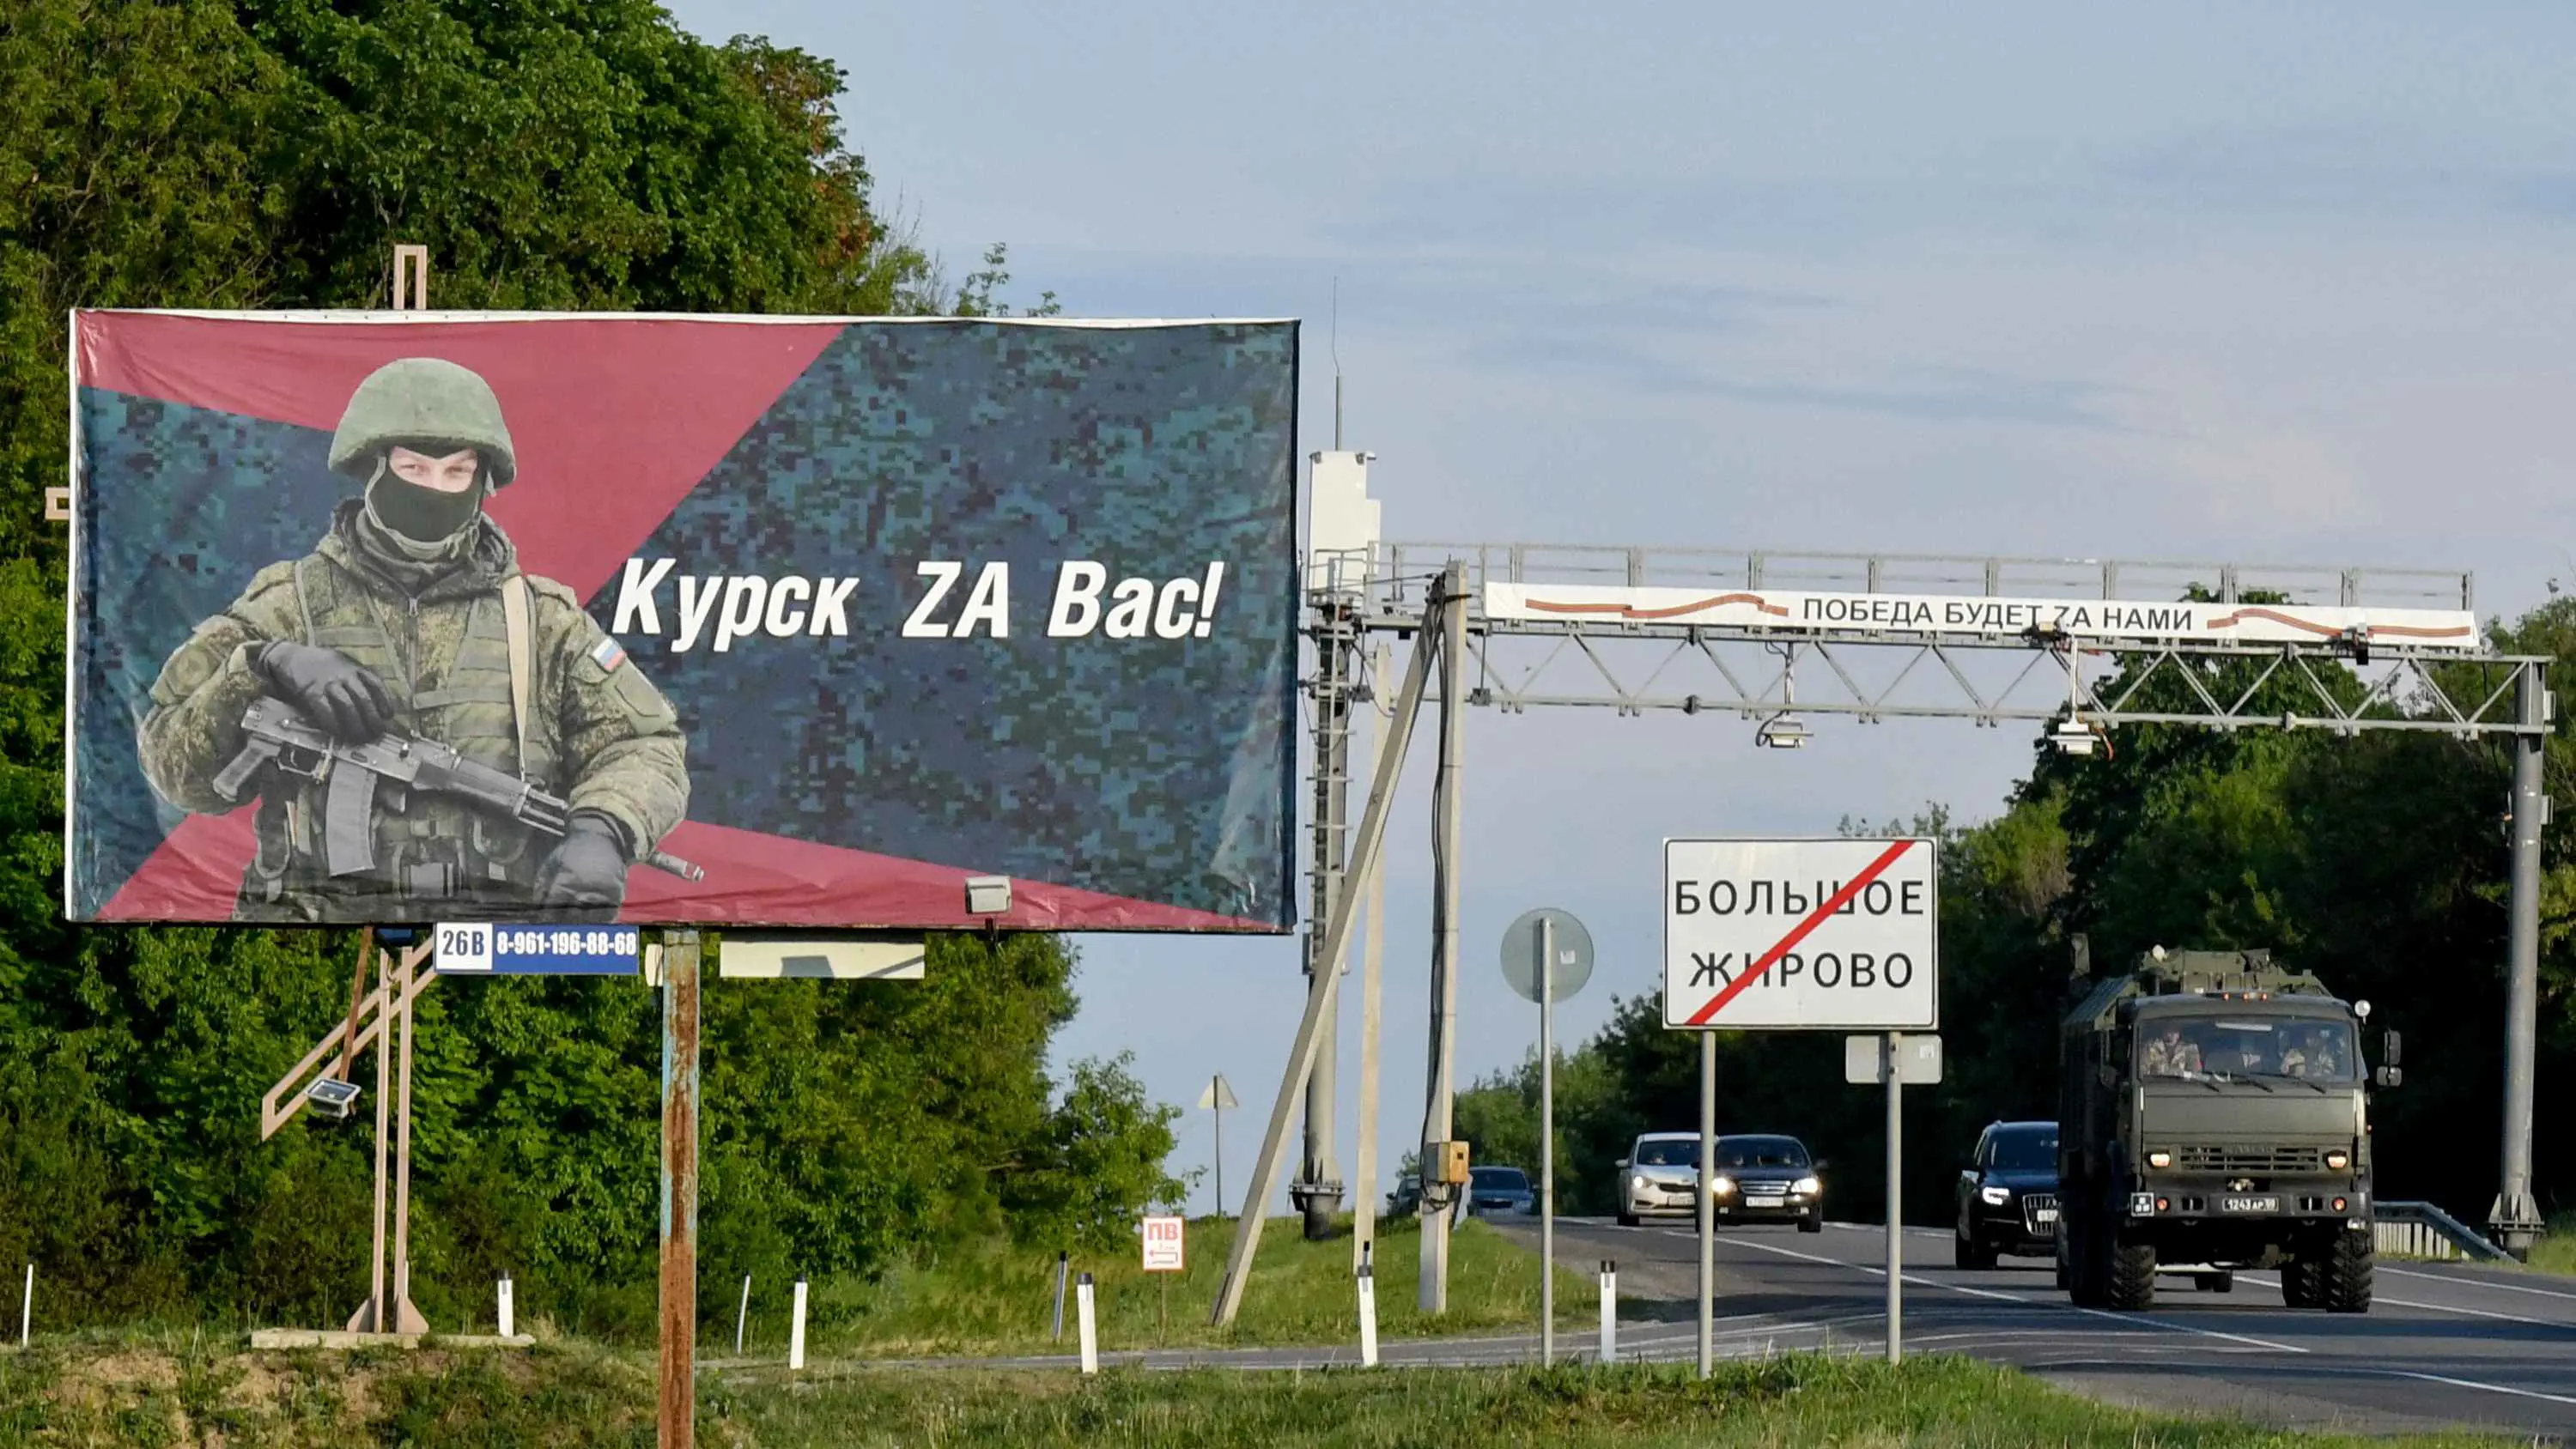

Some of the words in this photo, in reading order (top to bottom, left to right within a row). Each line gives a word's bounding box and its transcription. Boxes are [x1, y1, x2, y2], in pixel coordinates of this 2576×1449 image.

[611, 556, 860, 652] Курск
[902, 561, 1010, 638] ZA
[1047, 561, 1226, 640] Вас!
[1804, 598, 1934, 627] ПОБЕДА
[1945, 602, 2043, 628] БУДЕТ
[2104, 607, 2192, 630] НАМИ
[1675, 880, 1923, 915] БОЛЬШОЕ
[496, 931, 637, 955] 8-961-196-88-68
[1147, 1222, 1178, 1241] ПВ
